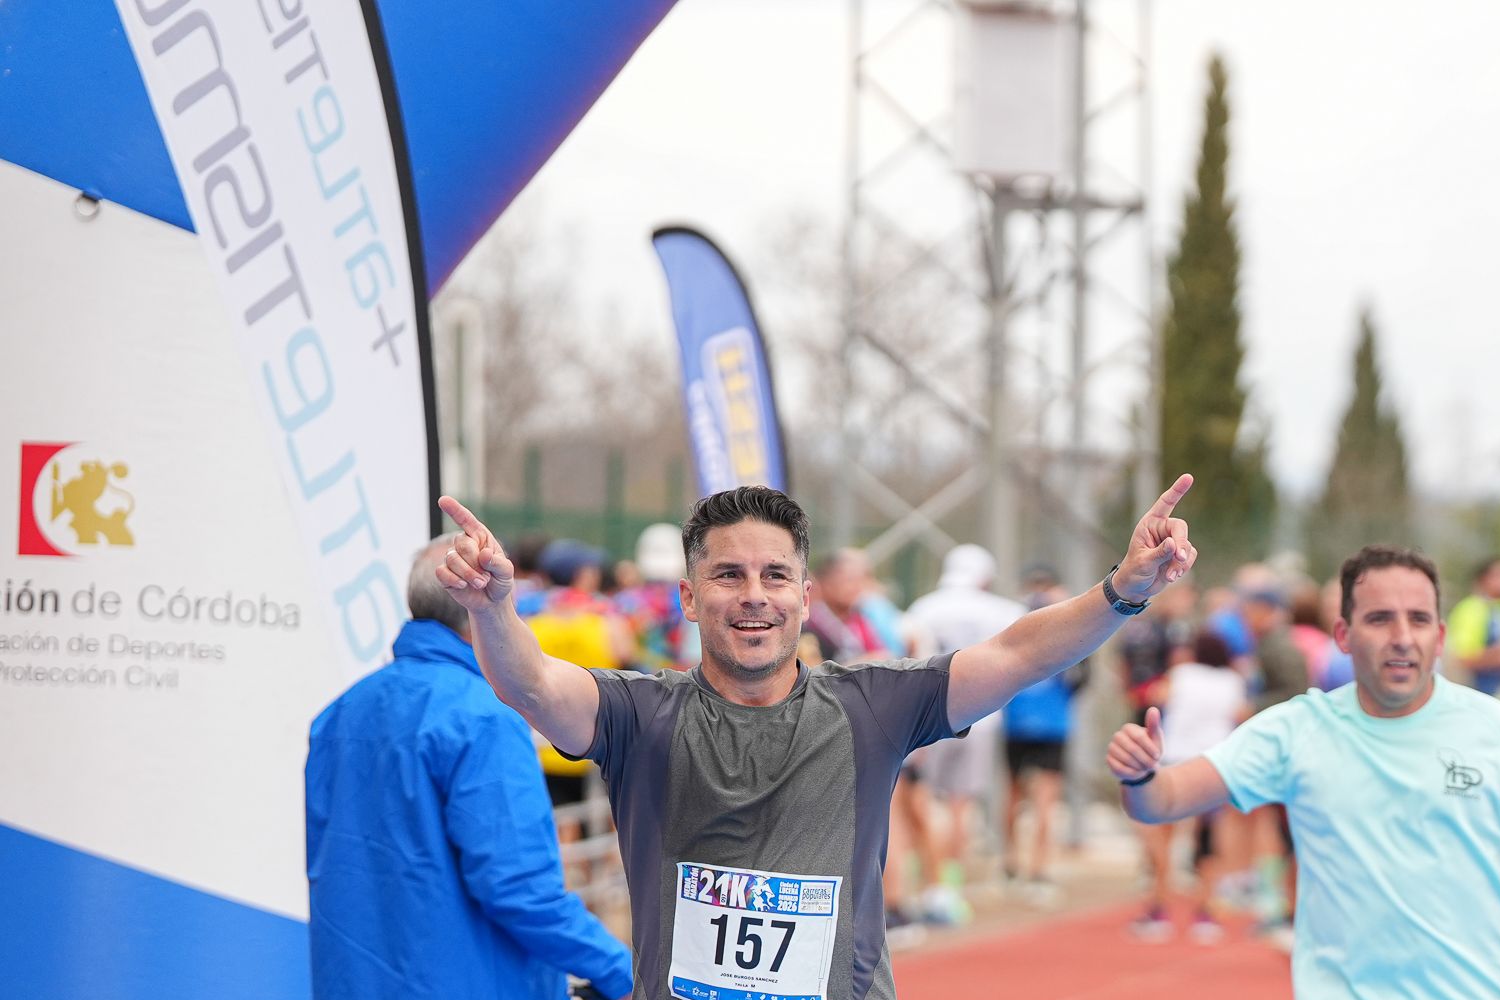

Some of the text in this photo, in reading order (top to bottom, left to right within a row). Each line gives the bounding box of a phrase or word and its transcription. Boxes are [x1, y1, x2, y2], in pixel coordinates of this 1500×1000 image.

[0, 578, 301, 630] ión de Córdoba
[67, 633, 100, 655] de
[107, 633, 227, 663] Deportes
[124, 664, 180, 689] Civil
[698, 869, 750, 908] 21K
[711, 914, 796, 973] 157
